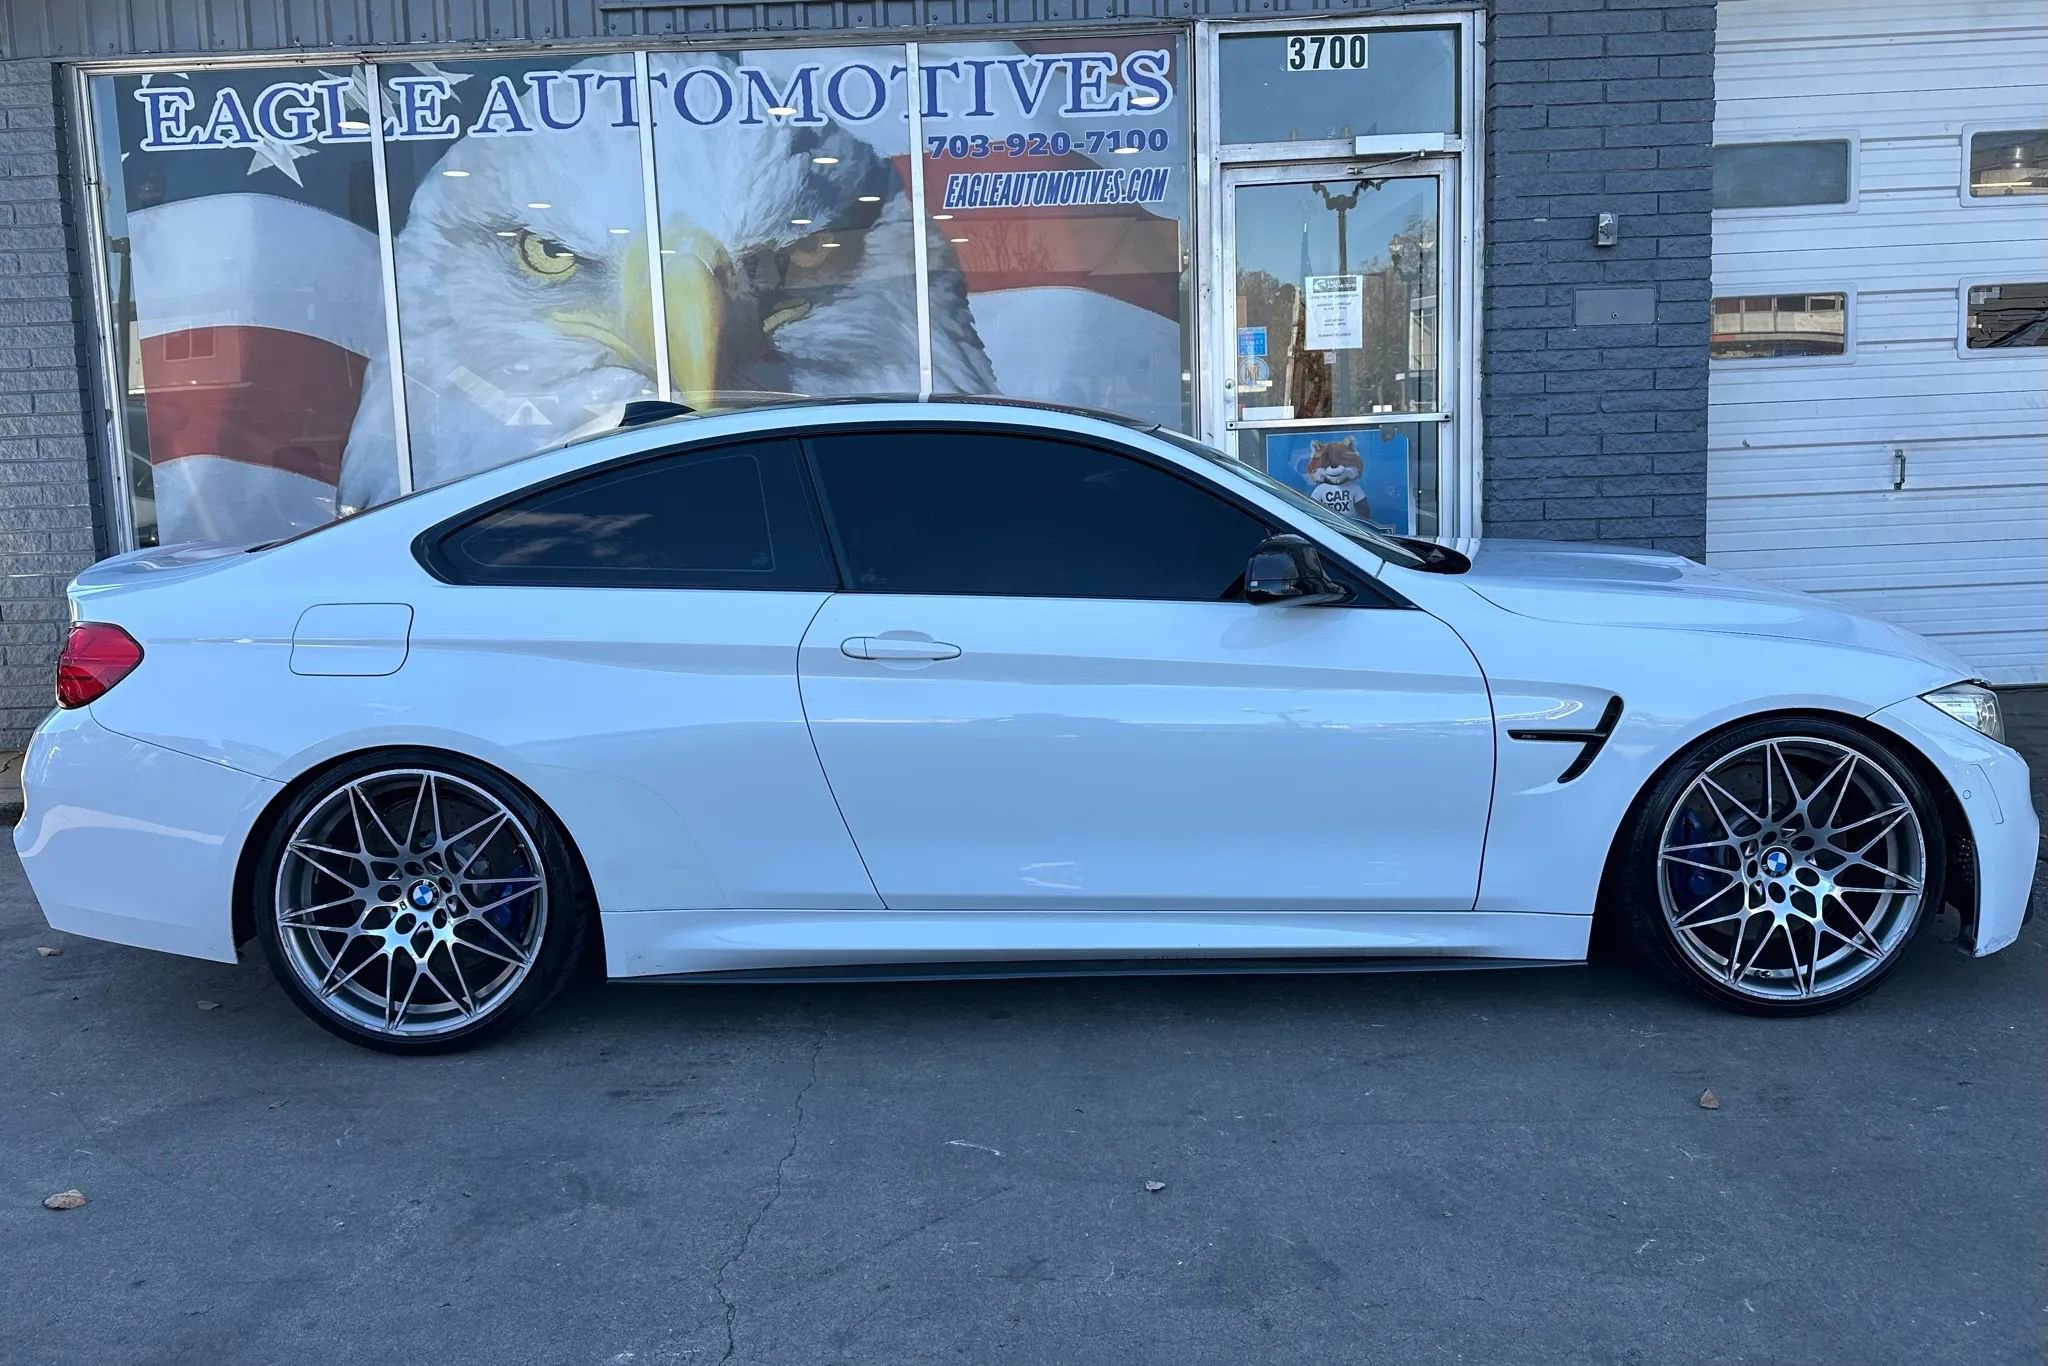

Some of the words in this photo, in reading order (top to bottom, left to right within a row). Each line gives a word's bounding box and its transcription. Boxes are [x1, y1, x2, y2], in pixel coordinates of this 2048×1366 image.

[1290, 35, 1365, 70] 3700
[136, 78, 458, 149] EAGLE
[470, 51, 1172, 135] AUTOMOTIVES
[928, 128, 1169, 159] 703-920-7100
[943, 167, 1170, 209] EAGLEAUTOMOTIVES.COM
[1326, 490, 1350, 502] CAR
[1327, 502, 1350, 512] FOX
